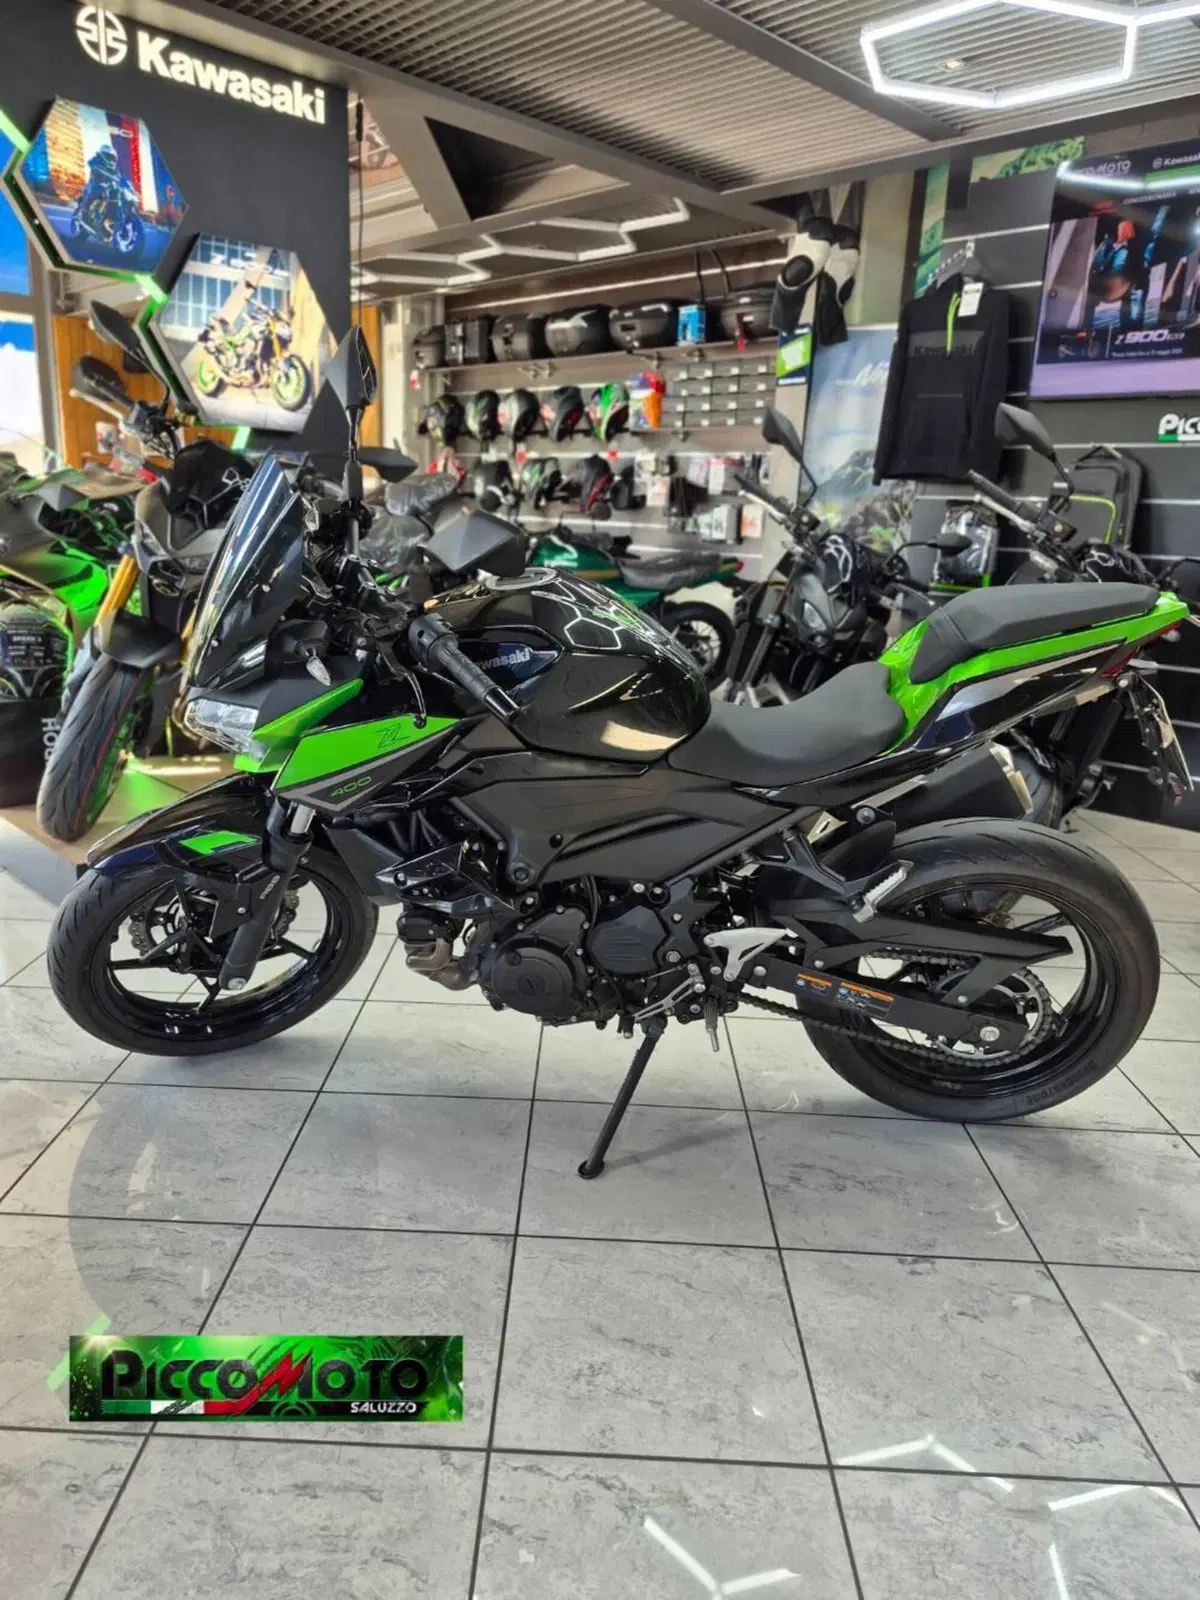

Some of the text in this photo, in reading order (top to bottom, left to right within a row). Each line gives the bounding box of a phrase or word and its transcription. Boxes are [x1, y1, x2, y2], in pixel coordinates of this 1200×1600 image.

[137, 30, 326, 124] Kawasaki
[1124, 329, 1169, 344] 900
[479, 647, 530, 669] wasaki
[330, 776, 372, 797] 400
